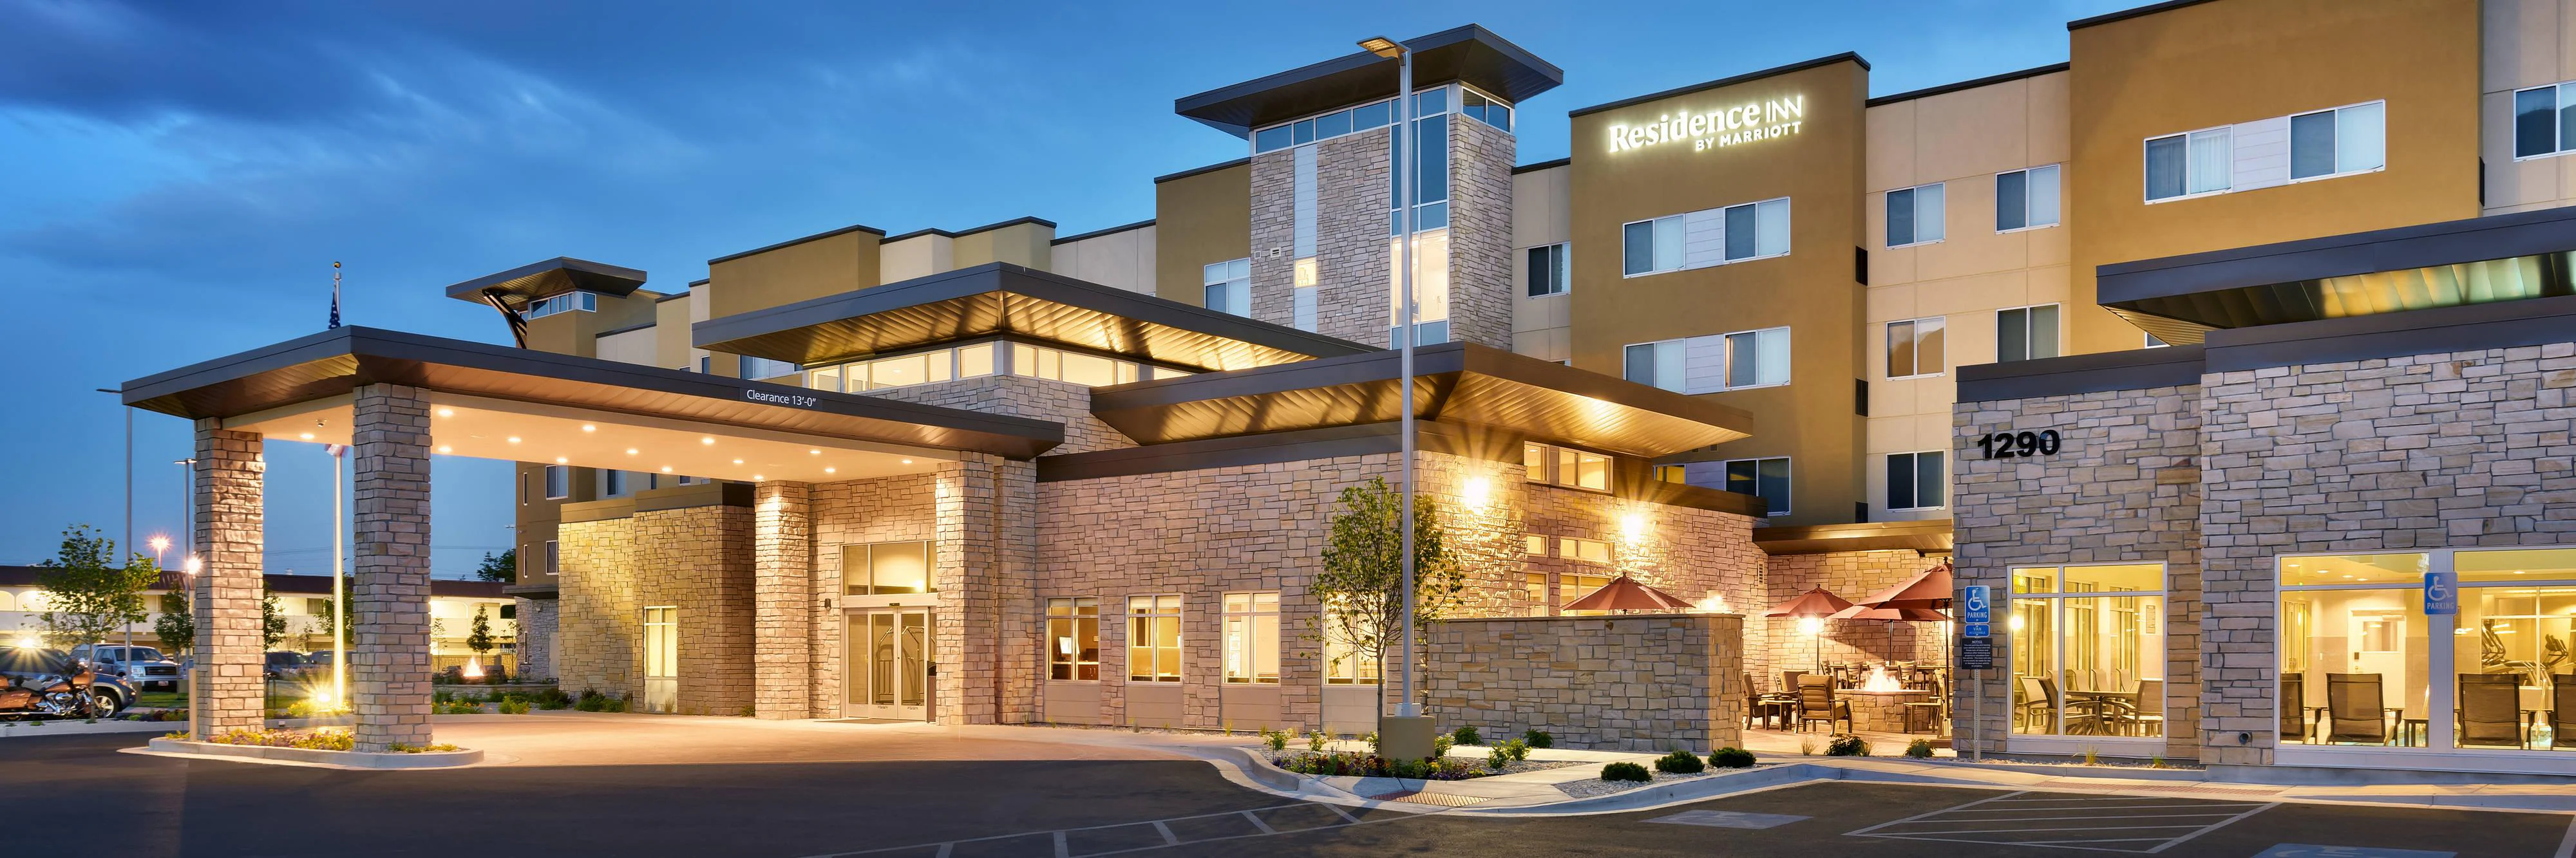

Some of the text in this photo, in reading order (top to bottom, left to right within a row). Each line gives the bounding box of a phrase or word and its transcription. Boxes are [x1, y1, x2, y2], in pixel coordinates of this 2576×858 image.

[1609, 95, 1802, 153] Residence INN
[1695, 121, 1802, 152] BY MARRIOTT
[746, 389, 790, 404] Clearance
[1977, 429, 2060, 459] 1290
